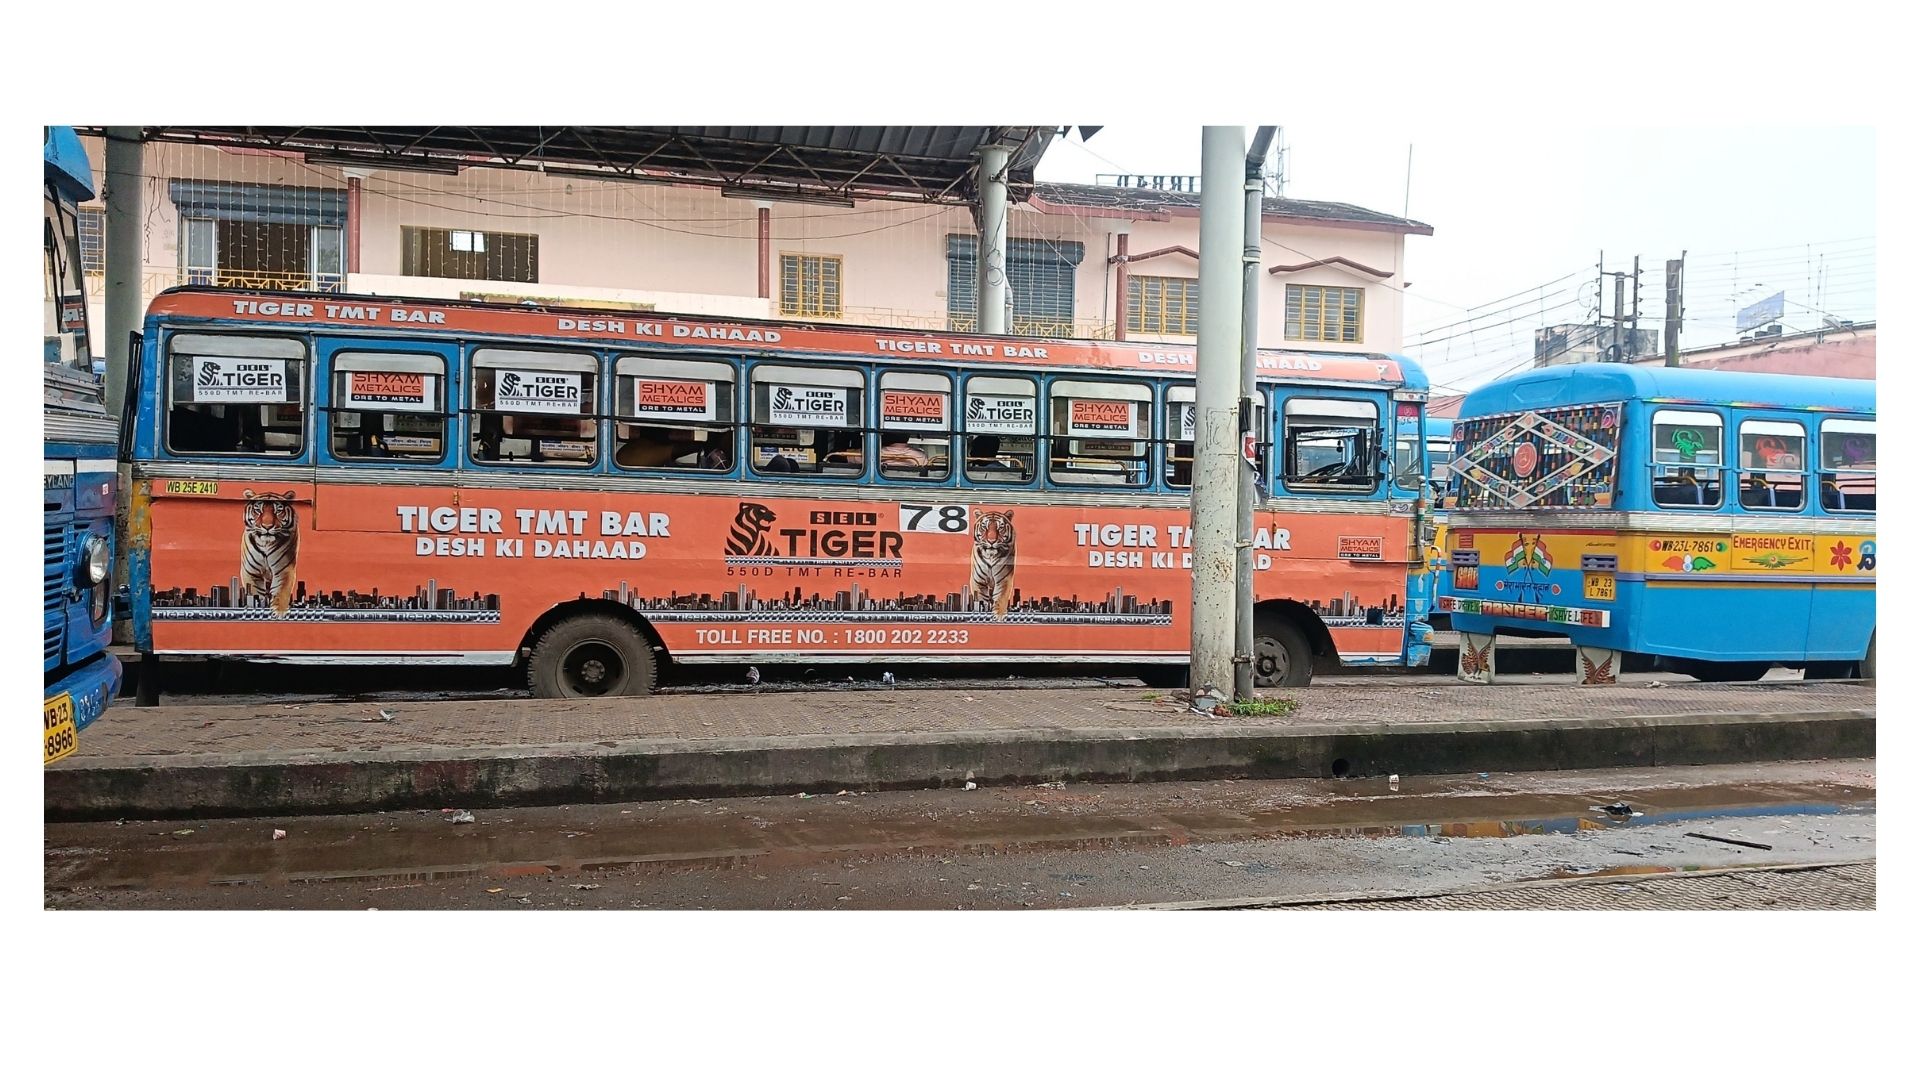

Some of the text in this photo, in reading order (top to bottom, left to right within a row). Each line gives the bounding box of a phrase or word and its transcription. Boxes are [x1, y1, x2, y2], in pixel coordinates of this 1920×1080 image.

[234, 301, 445, 324] TIGER TMT BAR
[558, 318, 781, 343] DESH KI DAHAAD
[876, 339, 1048, 358] TIGER TMT BAR
[1138, 352, 1322, 370] DESH HAAD
[223, 373, 282, 386] TIGER
[355, 373, 420, 384] SHYAM
[354, 384, 421, 393] METALICS
[523, 385, 578, 398] TIGER
[642, 384, 703, 395] SHYAM
[641, 395, 703, 404] METALICS
[795, 399, 844, 412] TIGER
[885, 395, 940, 406] SHYAM
[885, 406, 940, 415] METALICS
[987, 408, 1033, 420] TIGER
[1074, 404, 1126, 414] SHYAM
[1074, 414, 1126, 422] METALICS
[167, 481, 218, 494] WB 25E 2410
[397, 506, 671, 537] TIGER TMT BAR
[901, 504, 968, 532] 78
[1074, 523, 1157, 547] TIGER
[1252, 528, 1291, 549] AR
[416, 537, 647, 560] DESH KI DAHAAD
[780, 529, 903, 558] TIGER
[1733, 536, 1811, 552] EMERGENCY EXIT
[1089, 551, 1143, 567] DESH
[1152, 552, 1174, 568] KI
[727, 567, 902, 578] 550D TMT RE-BAR
[1592, 578, 1611, 587] WB 23
[1590, 588, 1612, 597] L 7861
[1443, 600, 1456, 609] SAFE
[1554, 609, 1572, 621] SAVE
[1575, 611, 1593, 624] LIFE
[696, 629, 741, 644] TOLL
[748, 629, 792, 644] FREE
[797, 629, 827, 644] NO.
[845, 629, 886, 644] 1800
[891, 629, 922, 644] 202
[927, 629, 968, 644] 2233
